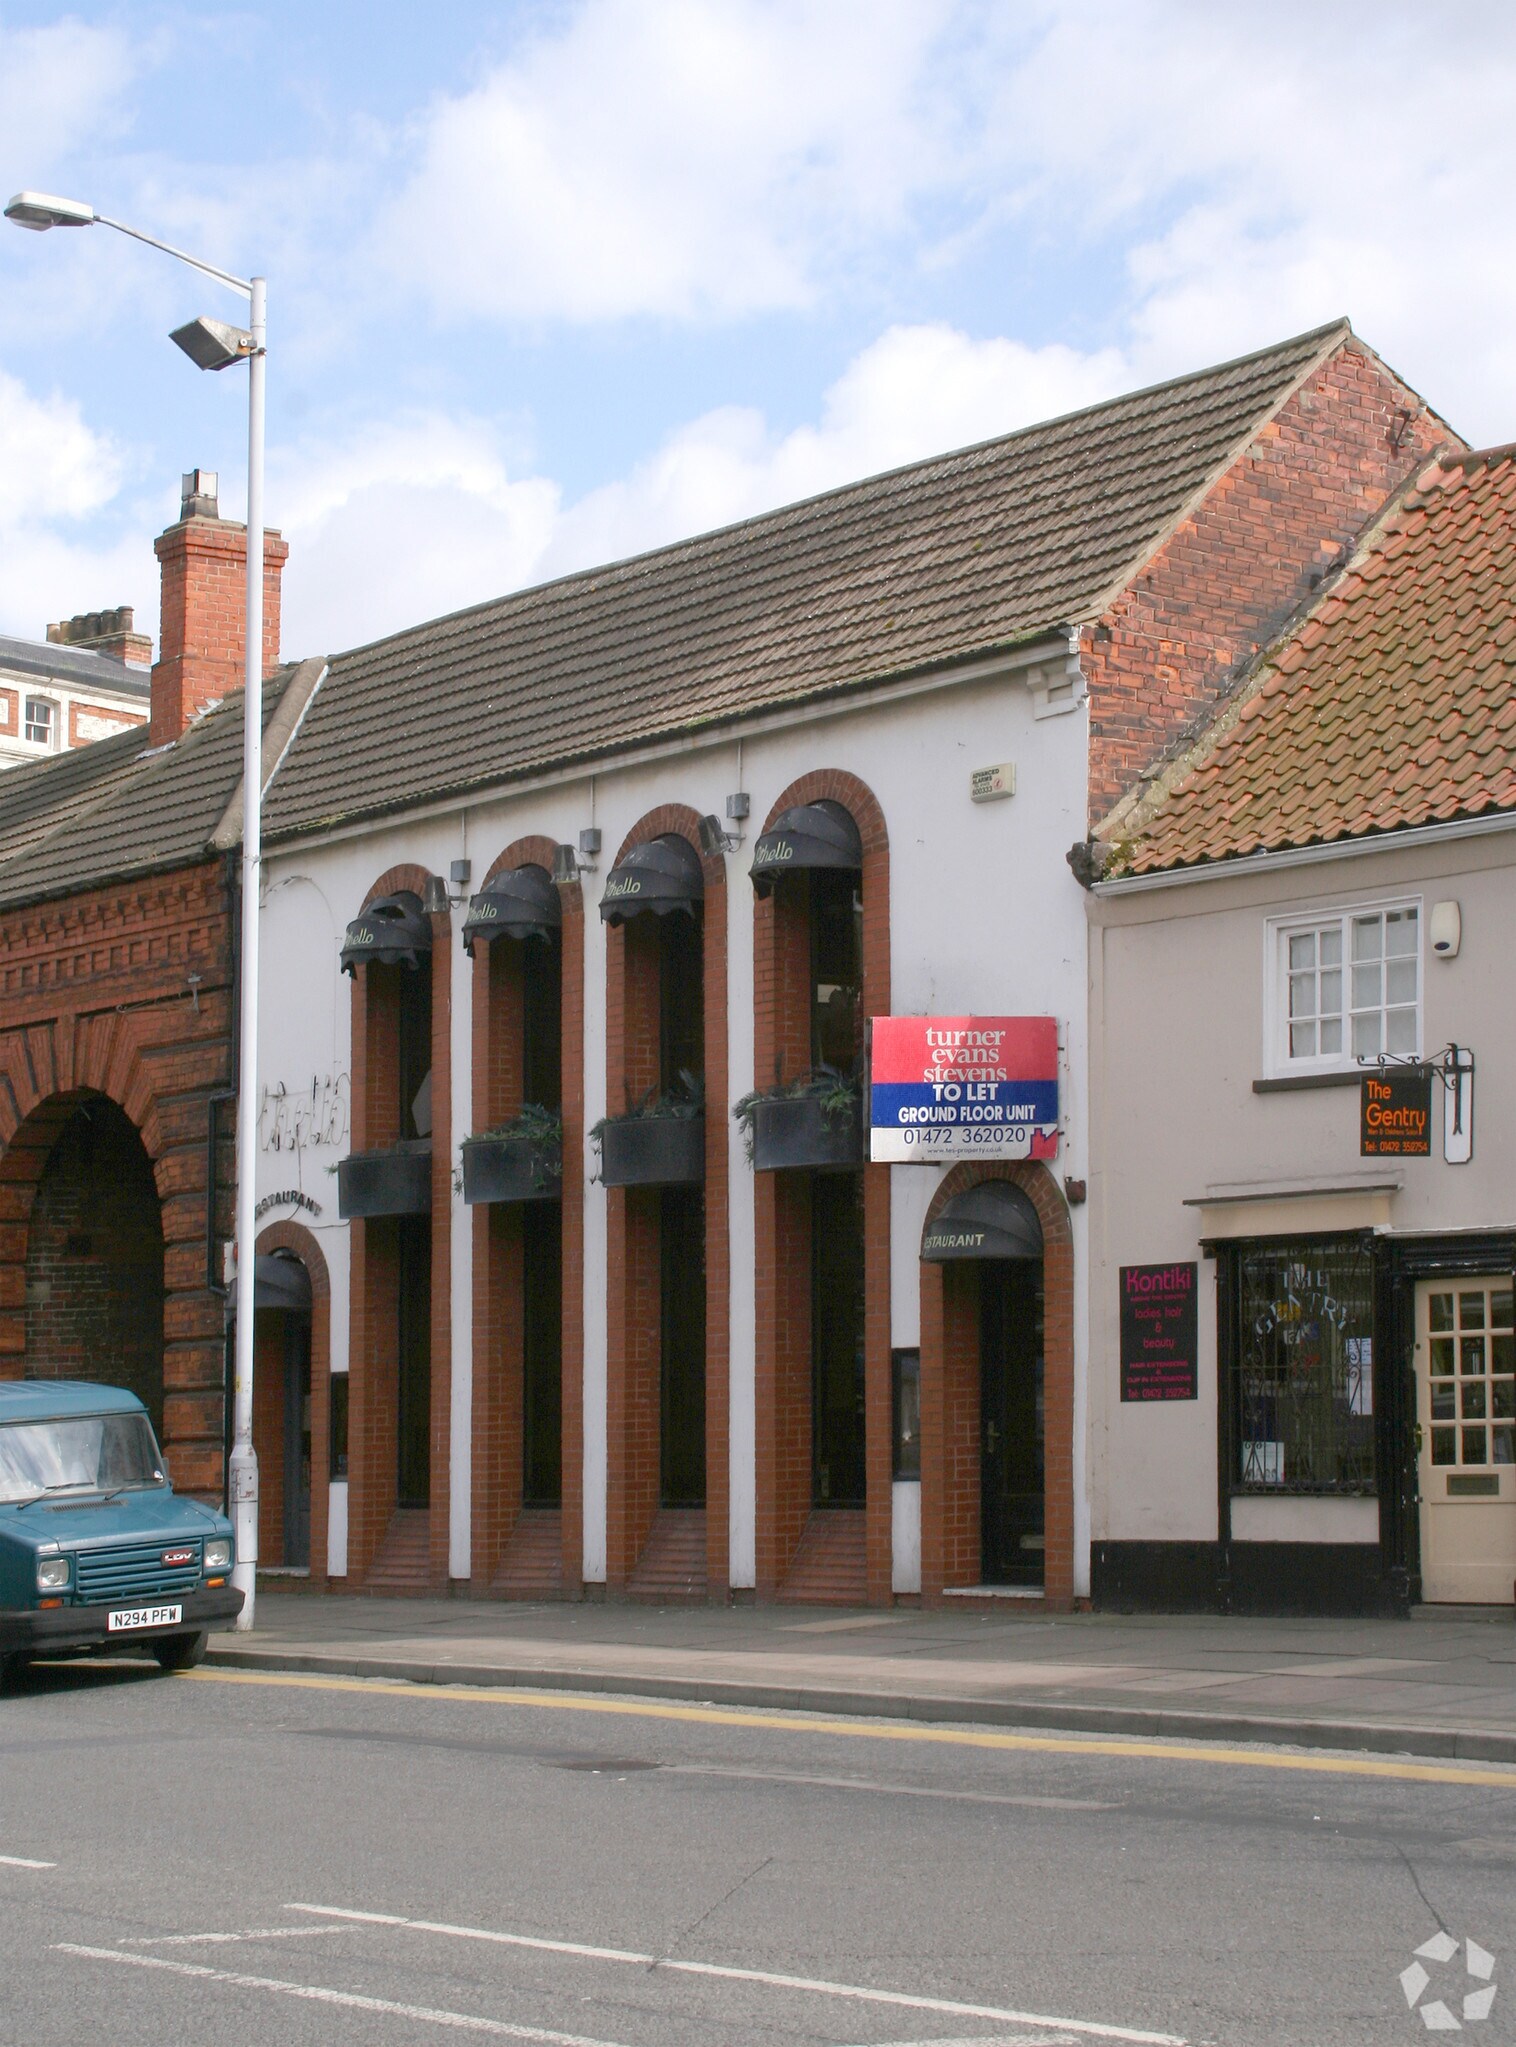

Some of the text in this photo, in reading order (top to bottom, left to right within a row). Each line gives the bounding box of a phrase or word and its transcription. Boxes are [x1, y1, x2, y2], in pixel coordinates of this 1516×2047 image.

[925, 1026, 1006, 1046] turner
[931, 1048, 1000, 1064] evans
[923, 1064, 1007, 1083] stevens
[932, 1083, 999, 1101] TO LET
[1366, 1080, 1392, 1099] The
[898, 1104, 1036, 1123] GROUND FLOOR UNIT
[1366, 1103, 1427, 1135] Gentry
[904, 1127, 1026, 1145] 01472 362020
[1126, 1266, 1191, 1293] Kontiki
[1281, 1269, 1330, 1289] THE
[1135, 1306, 1183, 1319] ladies hair
[1143, 1338, 1175, 1350] beauty
[114, 1607, 177, 1627] N294 PFW
